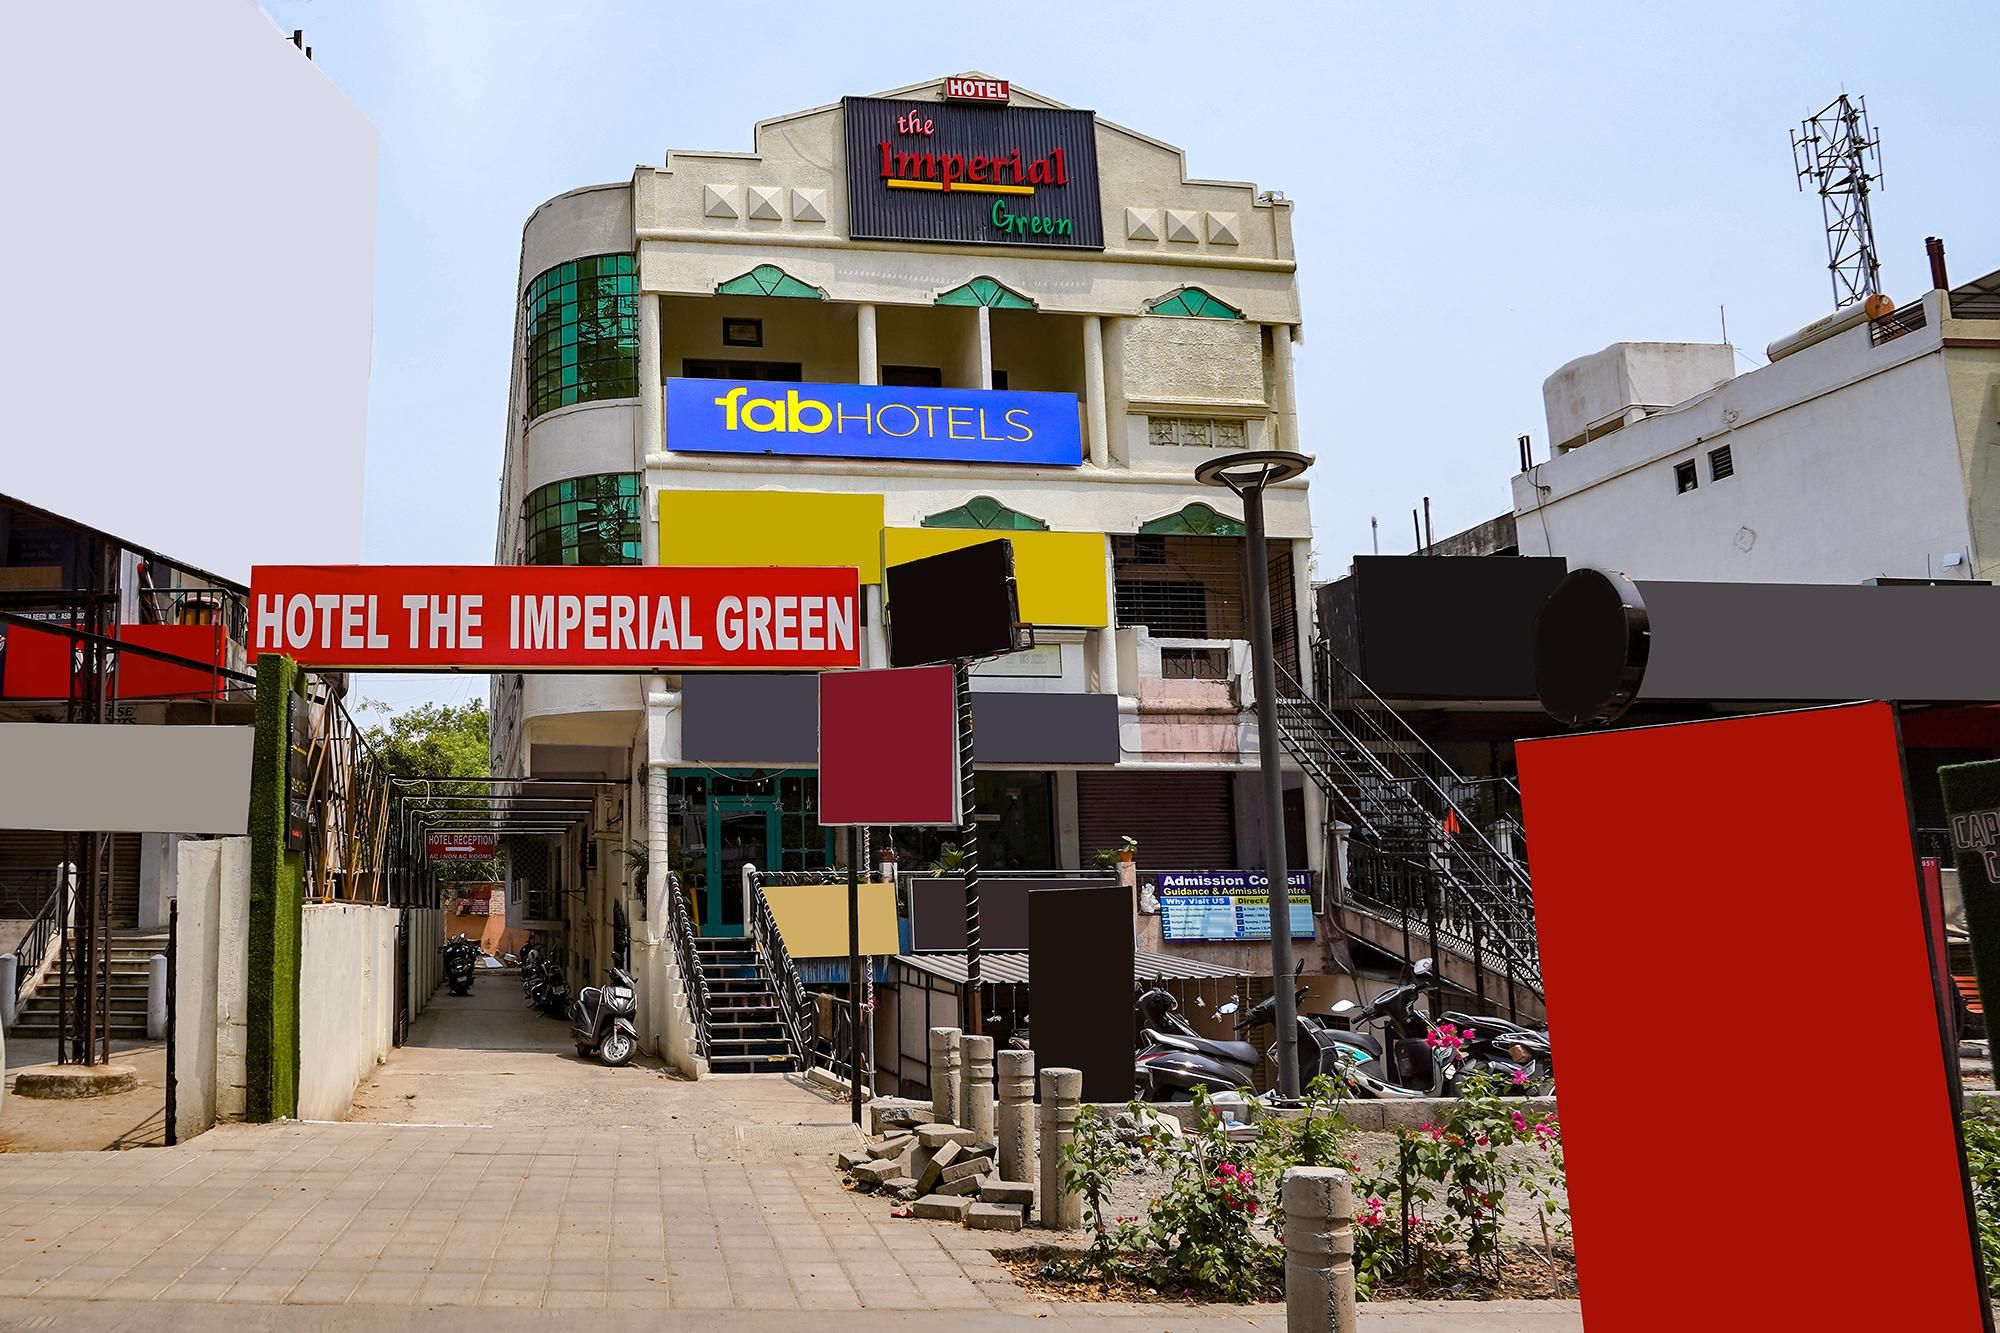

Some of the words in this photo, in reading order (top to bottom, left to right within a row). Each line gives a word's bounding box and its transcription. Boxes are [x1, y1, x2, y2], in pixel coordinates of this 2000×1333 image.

[950, 79, 1008, 99] HOTEL
[897, 109, 934, 137] the
[879, 141, 1069, 192] Imperial
[991, 199, 1073, 236] Green
[256, 593, 389, 649] HOTEL
[402, 594, 483, 649] THE
[509, 594, 703, 651] IMPERIAL
[716, 595, 854, 652] GREEN
[429, 835, 452, 845] HOTEL
[454, 835, 493, 845] RECEPTION
[1952, 812, 2000, 848] CAP
[1163, 875, 1244, 886] Admission
[1249, 875, 1305, 886] Cosil
[1163, 887, 1210, 896] Guidance
[1166, 897, 1184, 905] Why
